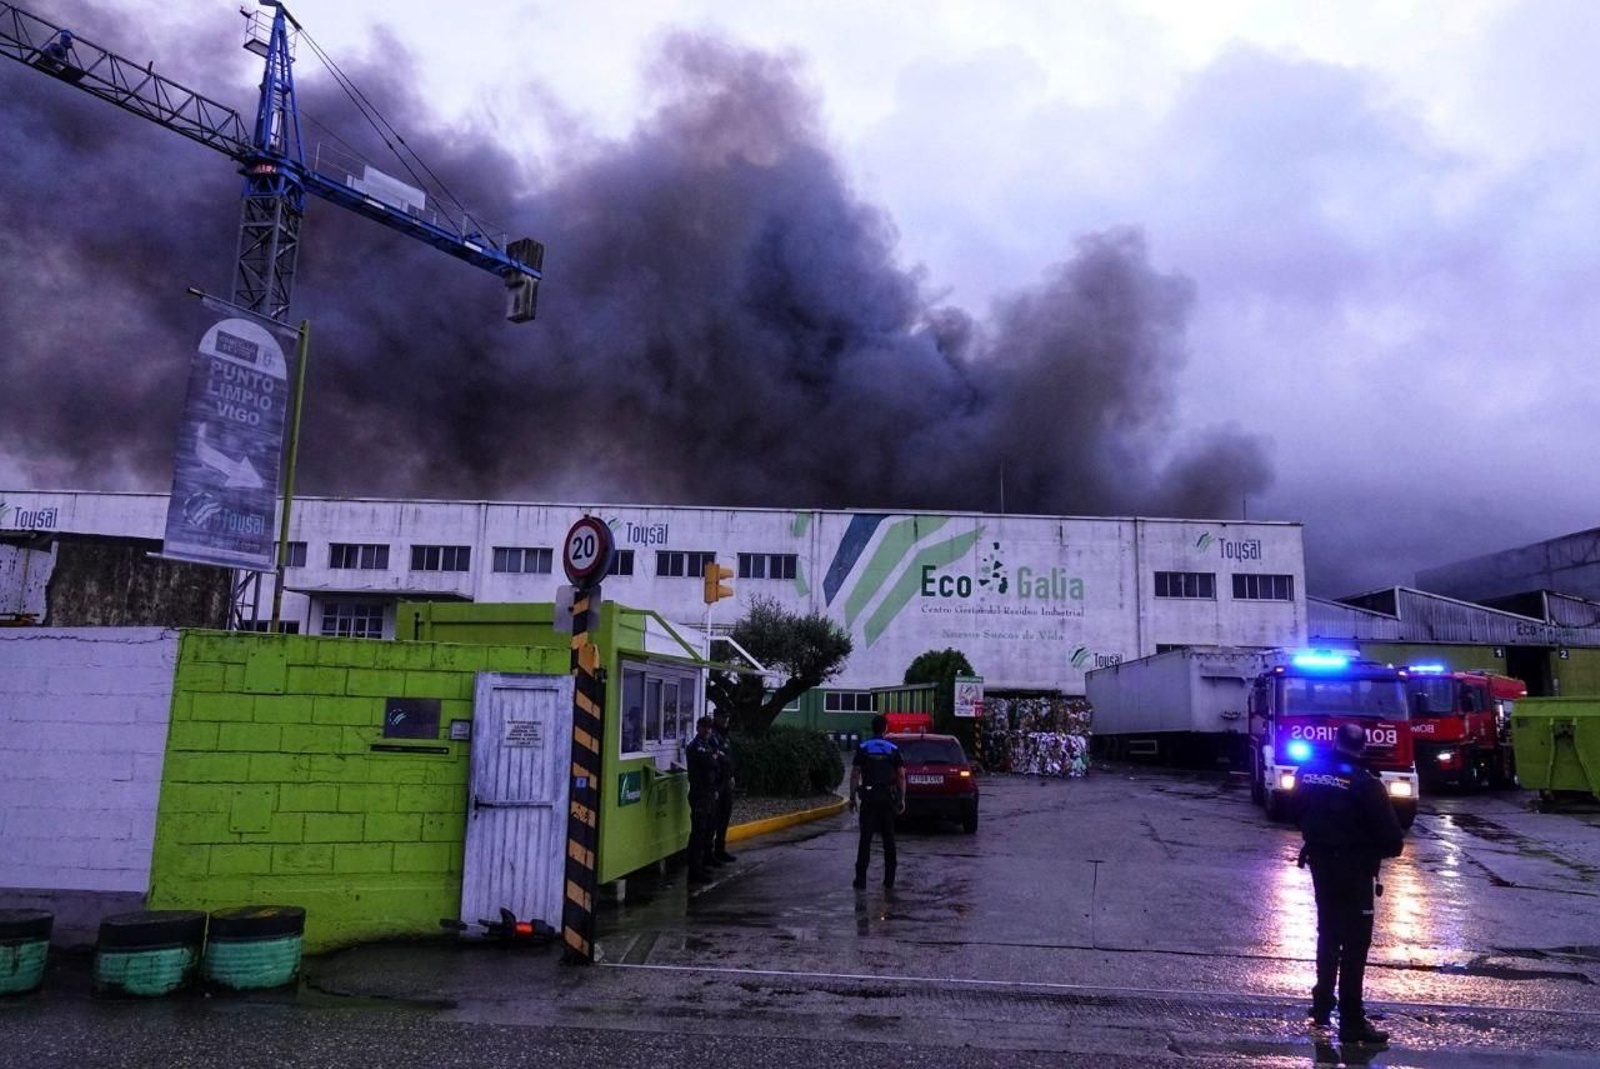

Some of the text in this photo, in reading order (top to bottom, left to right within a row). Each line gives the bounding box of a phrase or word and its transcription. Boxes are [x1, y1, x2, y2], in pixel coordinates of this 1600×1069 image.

[211, 360, 275, 393] PUNTO
[207, 379, 272, 411] LIMPIO
[217, 400, 260, 426] VIGO
[572, 534, 595, 561] 20
[920, 565, 1084, 601] Eco Galia
